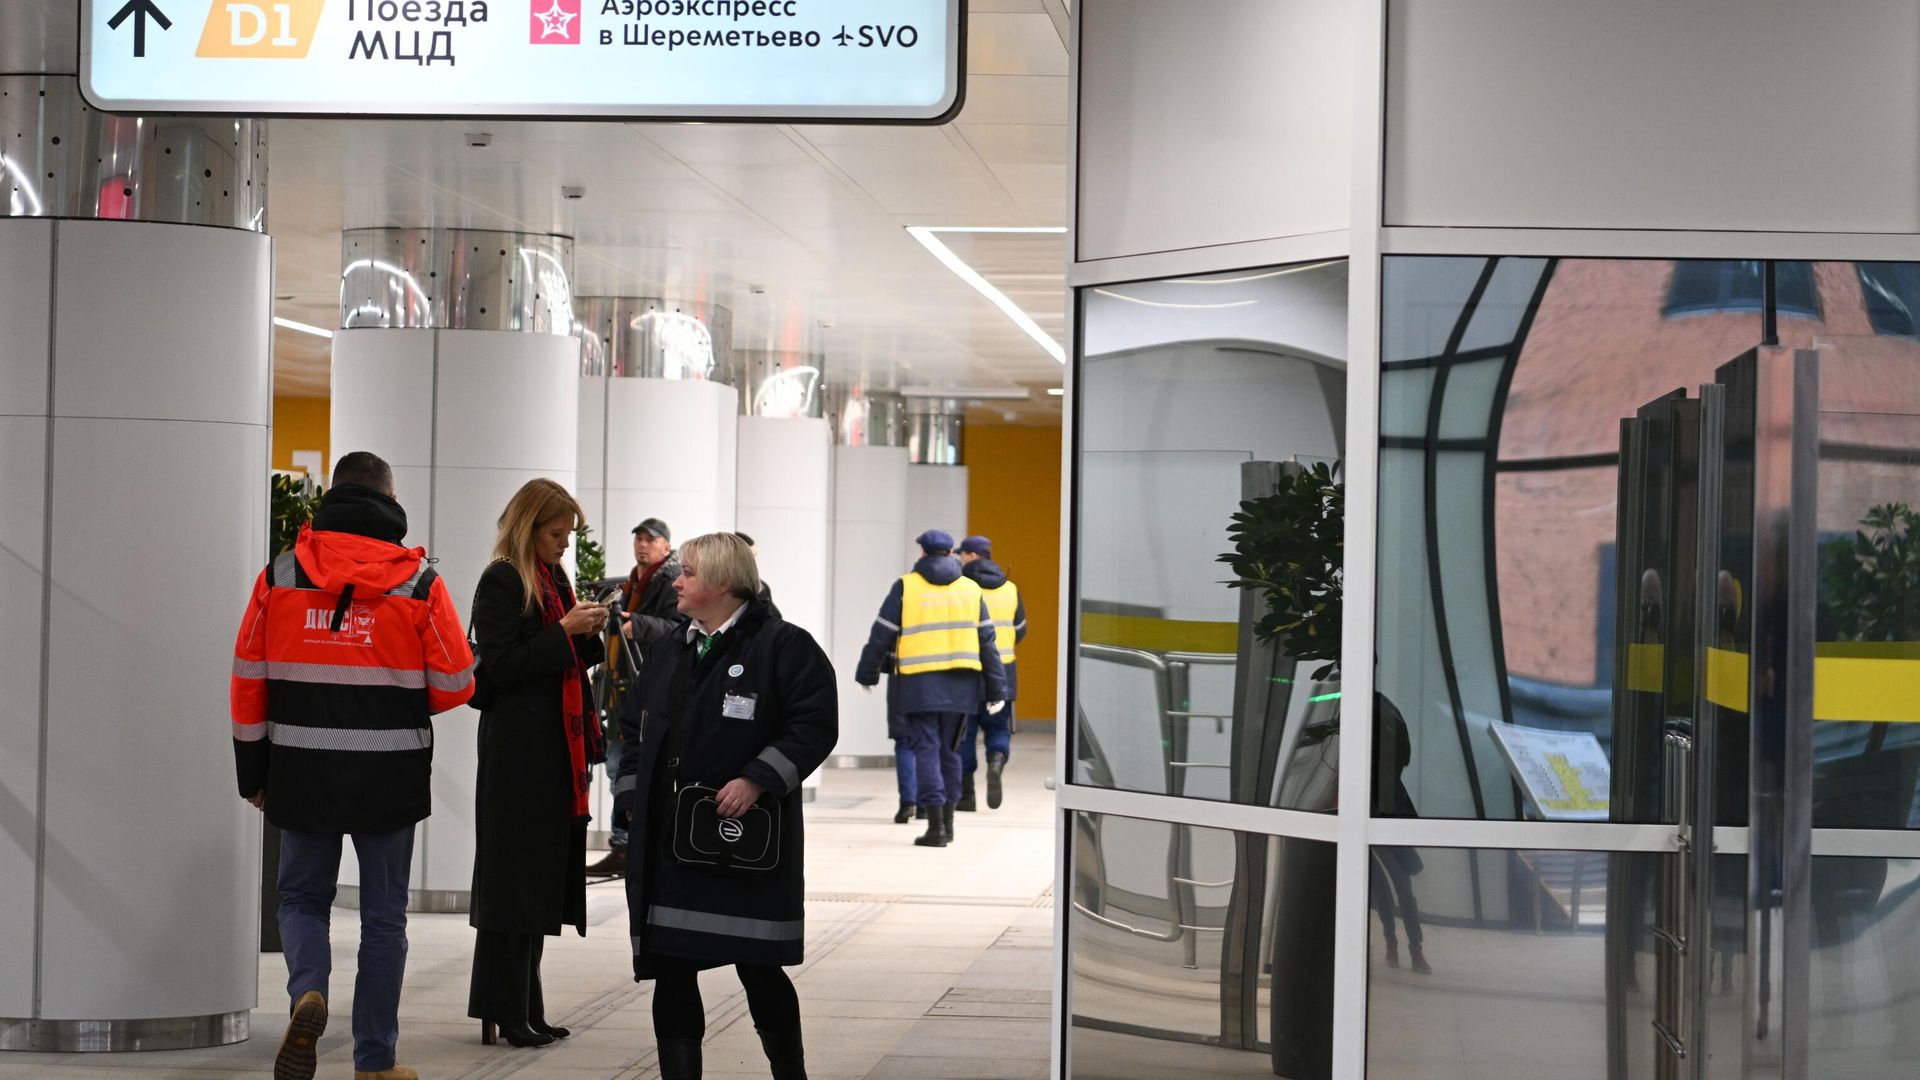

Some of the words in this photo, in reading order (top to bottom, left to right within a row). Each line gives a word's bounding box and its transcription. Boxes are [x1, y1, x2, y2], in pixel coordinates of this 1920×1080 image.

[226, 4, 297, 46] D1
[600, 0, 797, 21] Аэроэкспресс
[349, 30, 455, 66] МЦД
[600, 28, 613, 46] в
[623, 24, 820, 51] Шереметьево
[858, 25, 918, 48] SVO
